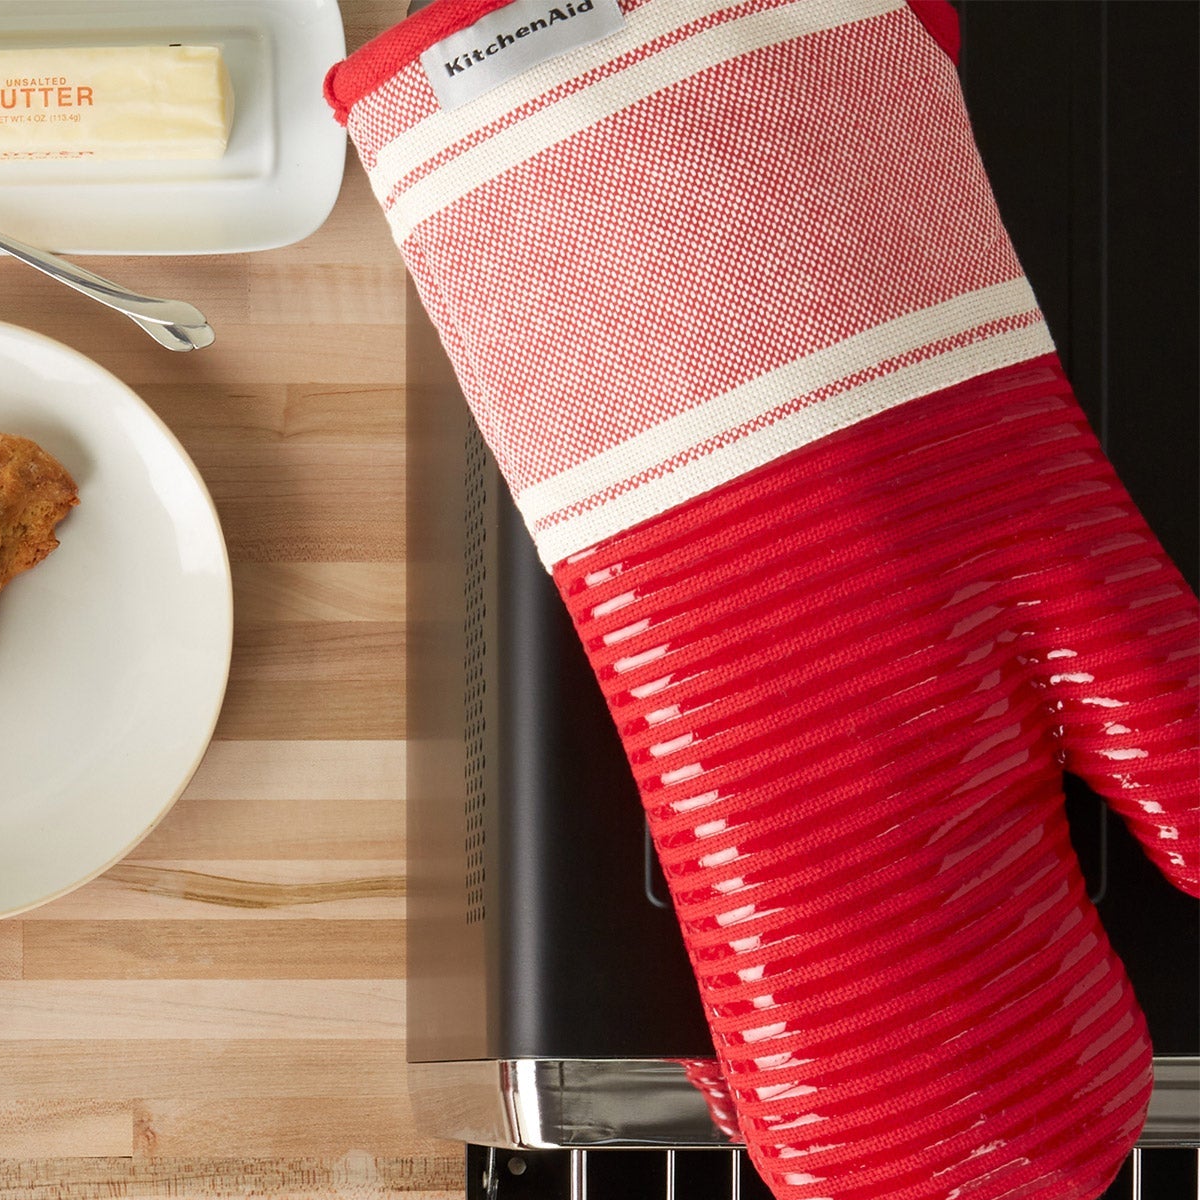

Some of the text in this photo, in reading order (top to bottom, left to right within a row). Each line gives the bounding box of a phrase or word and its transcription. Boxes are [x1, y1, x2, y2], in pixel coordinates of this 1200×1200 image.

[444, 0, 594, 77] KitchenAid
[6, 77, 67, 87] UNSALTED
[49, 113, 81, 123] (113.4g)
